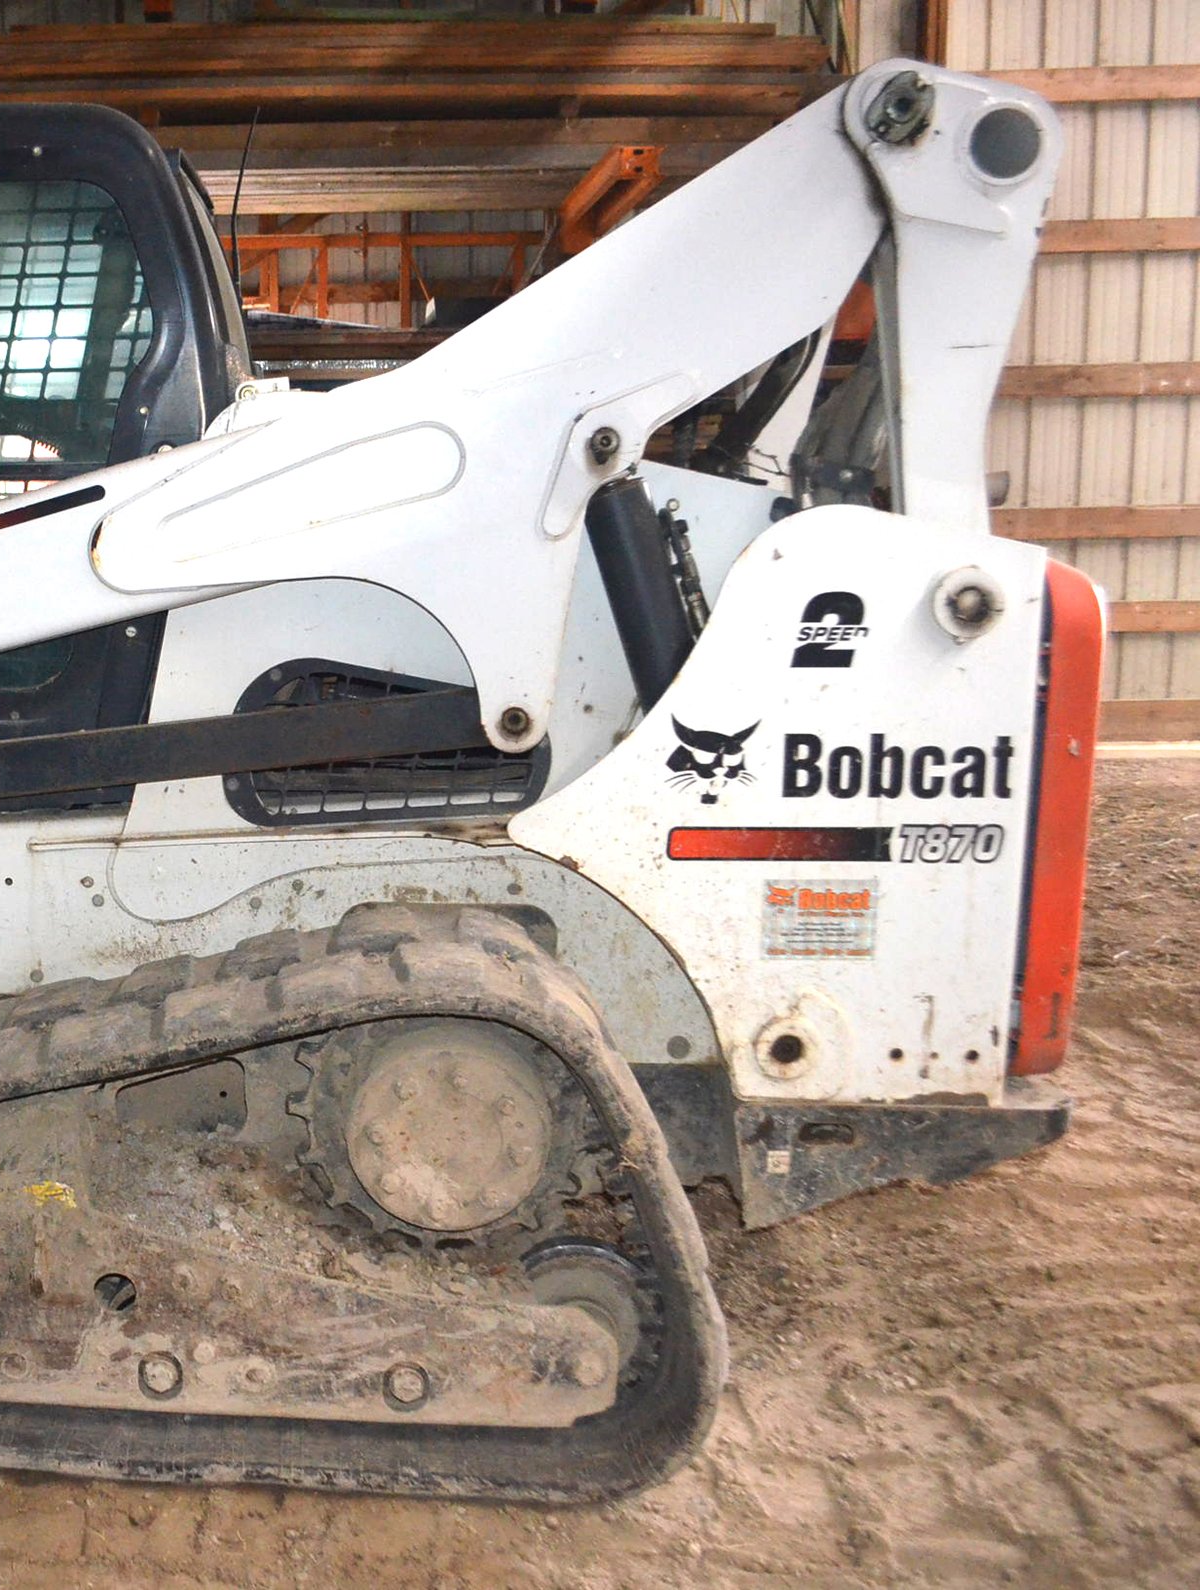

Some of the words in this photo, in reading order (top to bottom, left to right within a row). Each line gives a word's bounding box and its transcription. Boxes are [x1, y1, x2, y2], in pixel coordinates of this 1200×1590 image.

[790, 591, 865, 668] 2
[782, 733, 1014, 799] Bobcat
[899, 824, 1005, 864] T870
[798, 888, 871, 911] Bobcat
